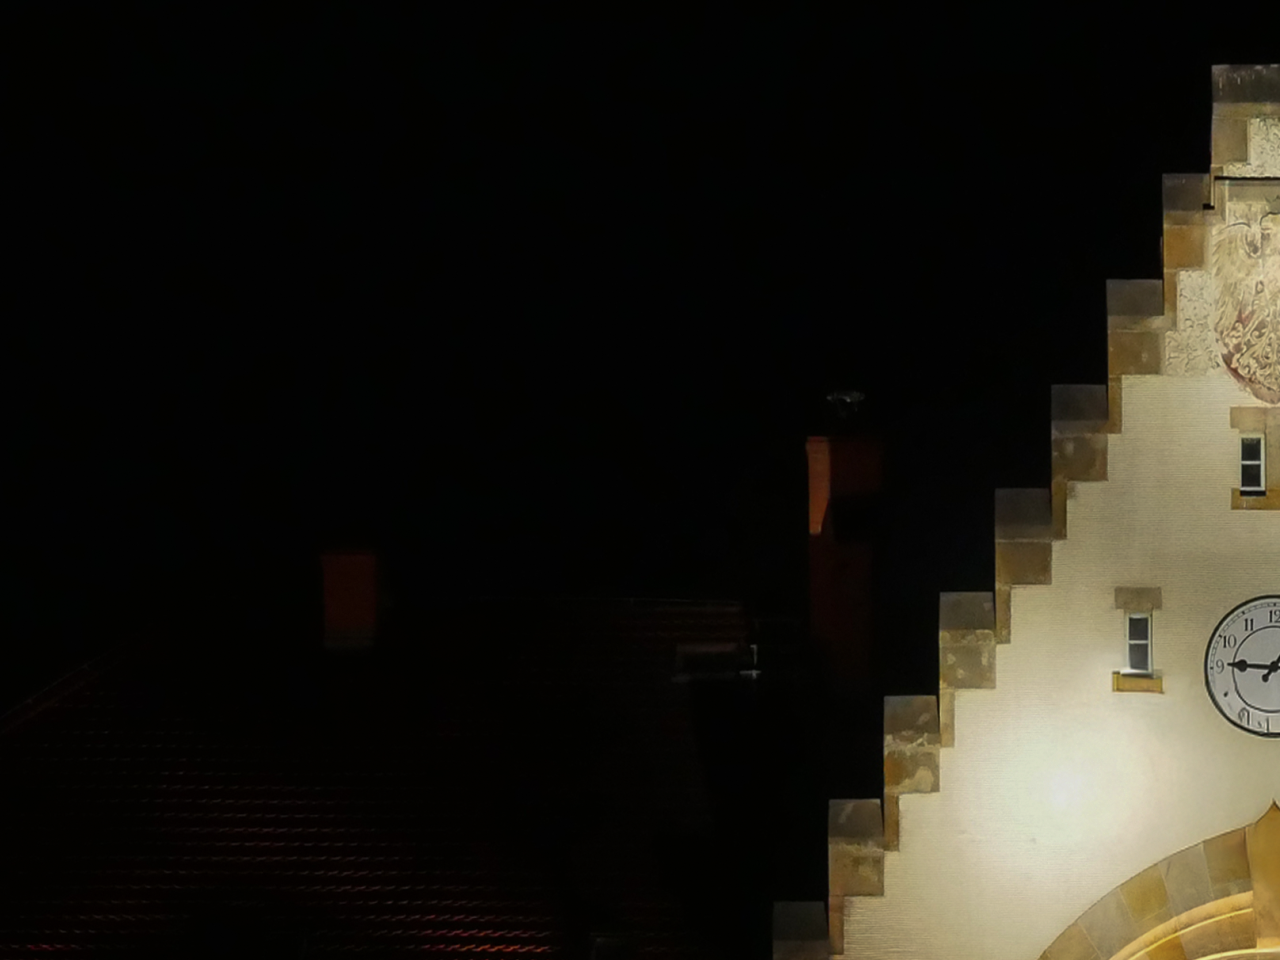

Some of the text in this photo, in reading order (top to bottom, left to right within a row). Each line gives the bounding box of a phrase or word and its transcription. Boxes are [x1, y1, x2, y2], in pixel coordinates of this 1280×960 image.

[1244, 618, 1254, 632] 11
[1222, 634, 1237, 649] 10
[1215, 659, 1225, 674] 9
